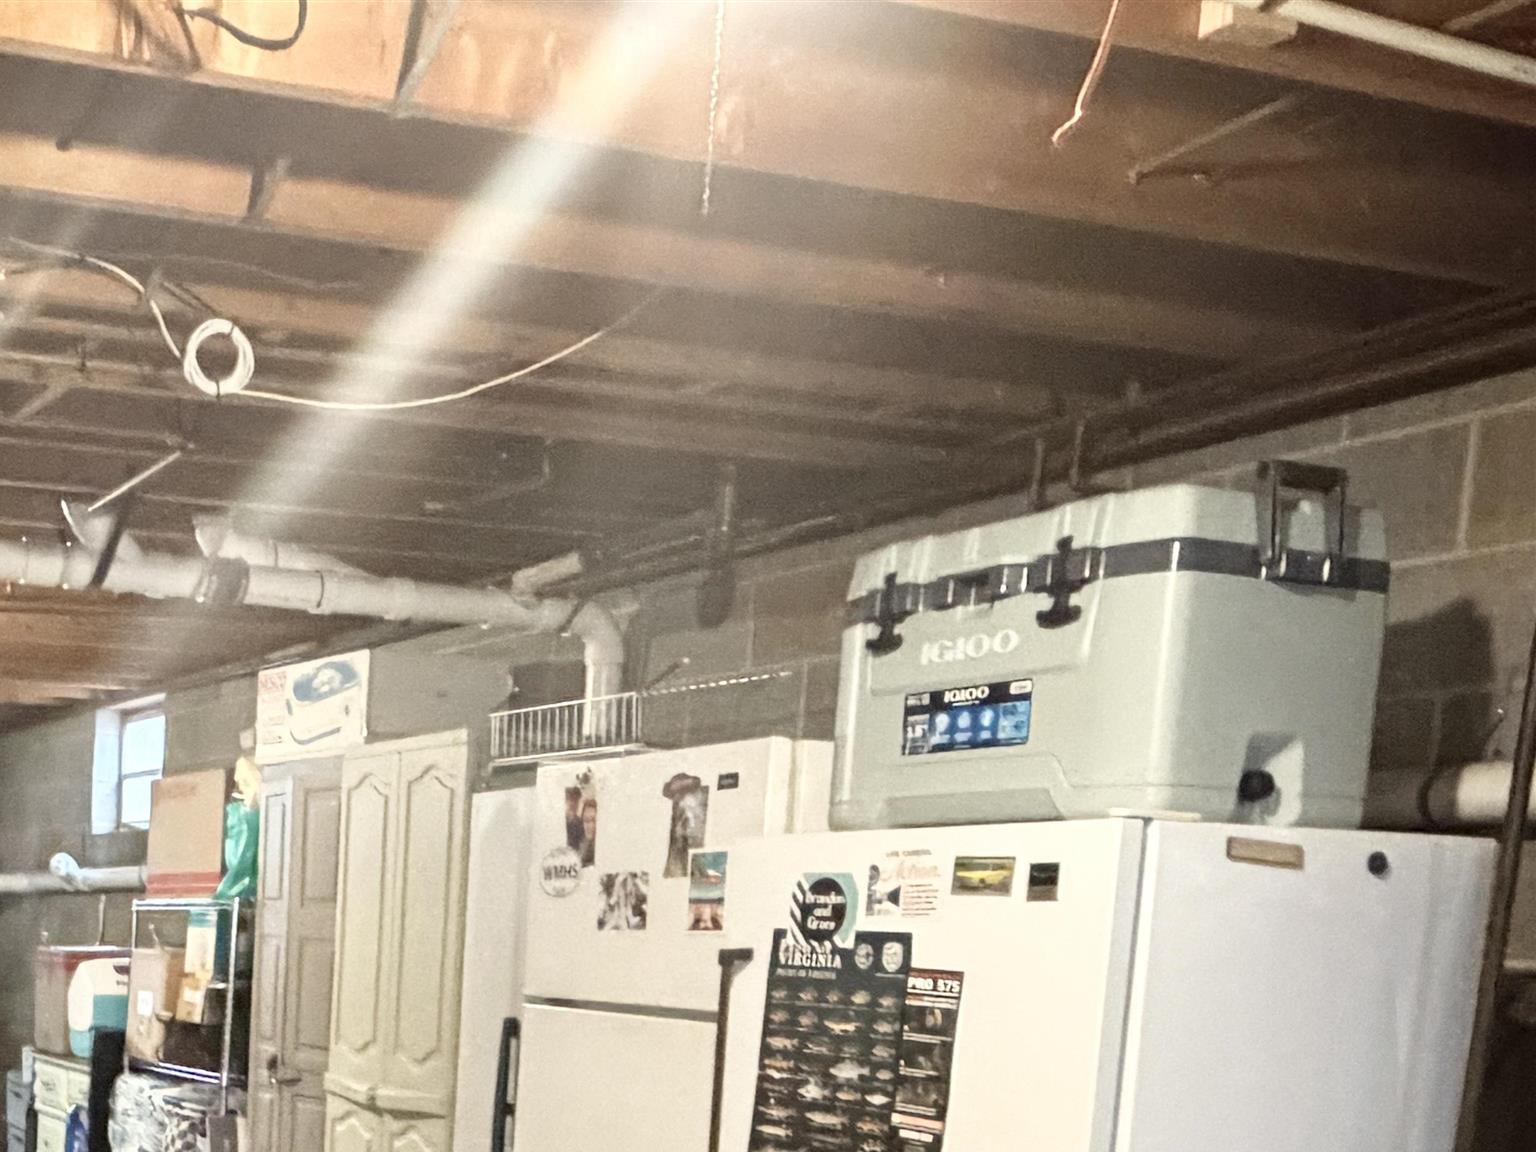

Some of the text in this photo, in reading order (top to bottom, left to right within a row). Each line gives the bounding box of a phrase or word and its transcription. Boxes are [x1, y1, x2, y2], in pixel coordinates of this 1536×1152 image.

[921, 629, 1019, 664] IGLOO
[943, 686, 989, 702] IGLOO
[779, 951, 842, 969] VIRGINIA
